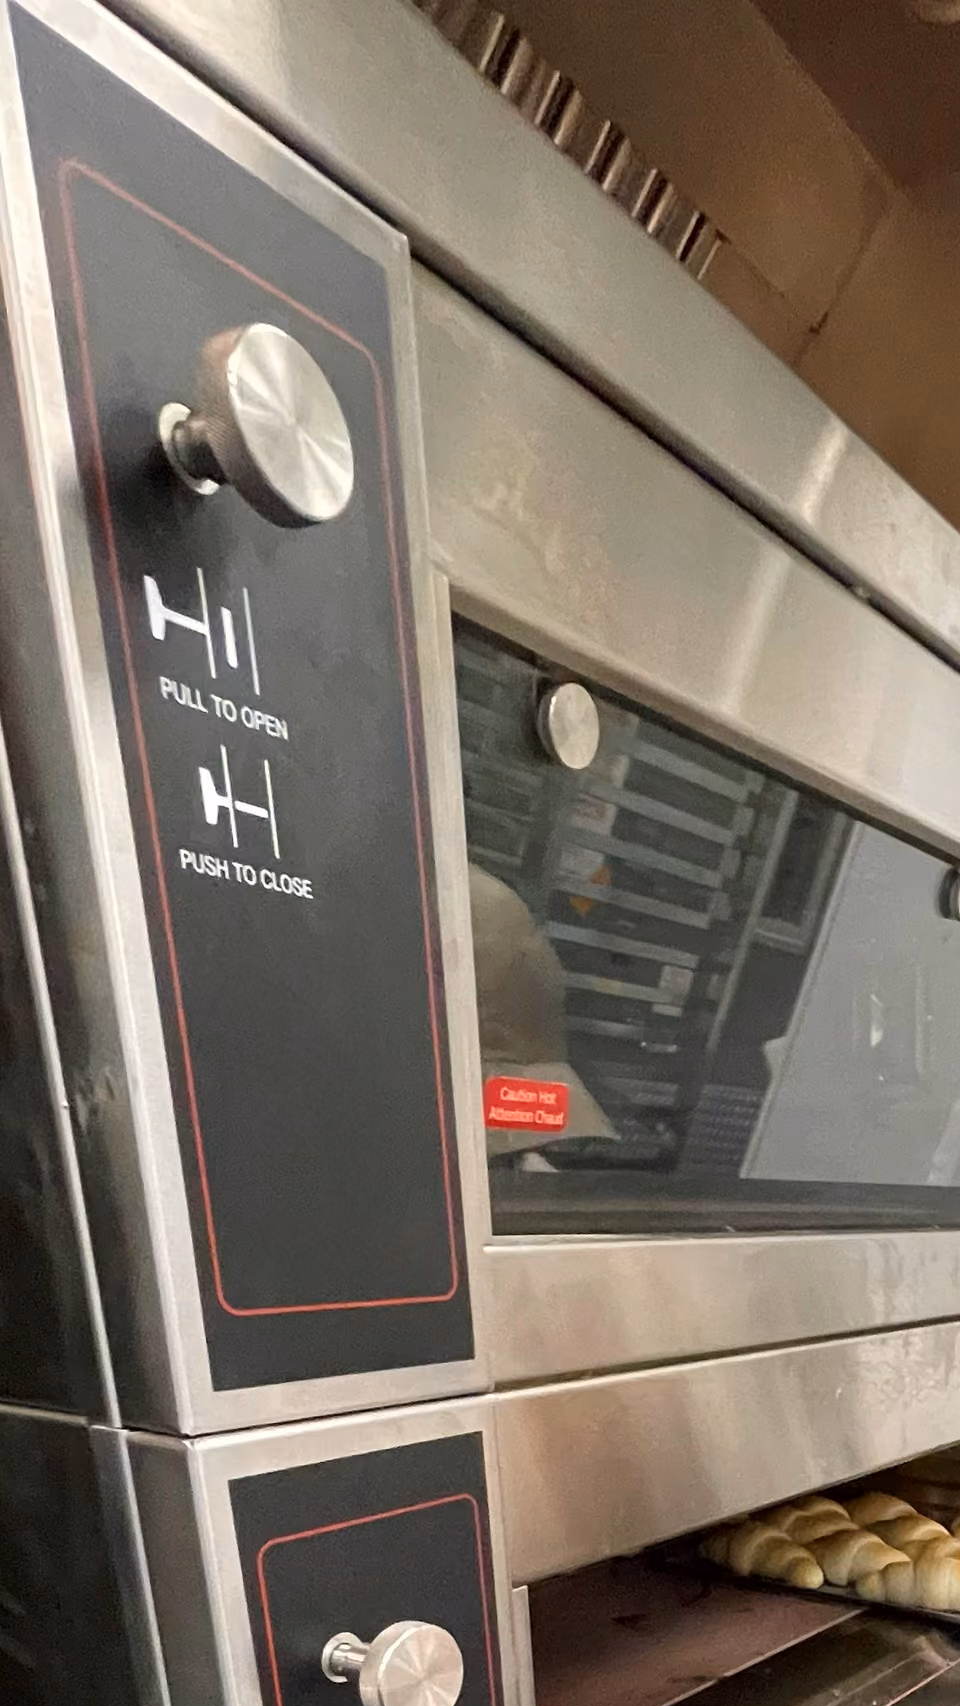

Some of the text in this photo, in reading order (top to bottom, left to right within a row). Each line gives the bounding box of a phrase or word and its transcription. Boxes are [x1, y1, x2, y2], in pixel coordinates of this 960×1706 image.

[160, 676, 289, 740] PULL TO OPEN
[179, 848, 315, 900] PUSH TO CLOSE
[500, 1086, 557, 1104] Caution Hot
